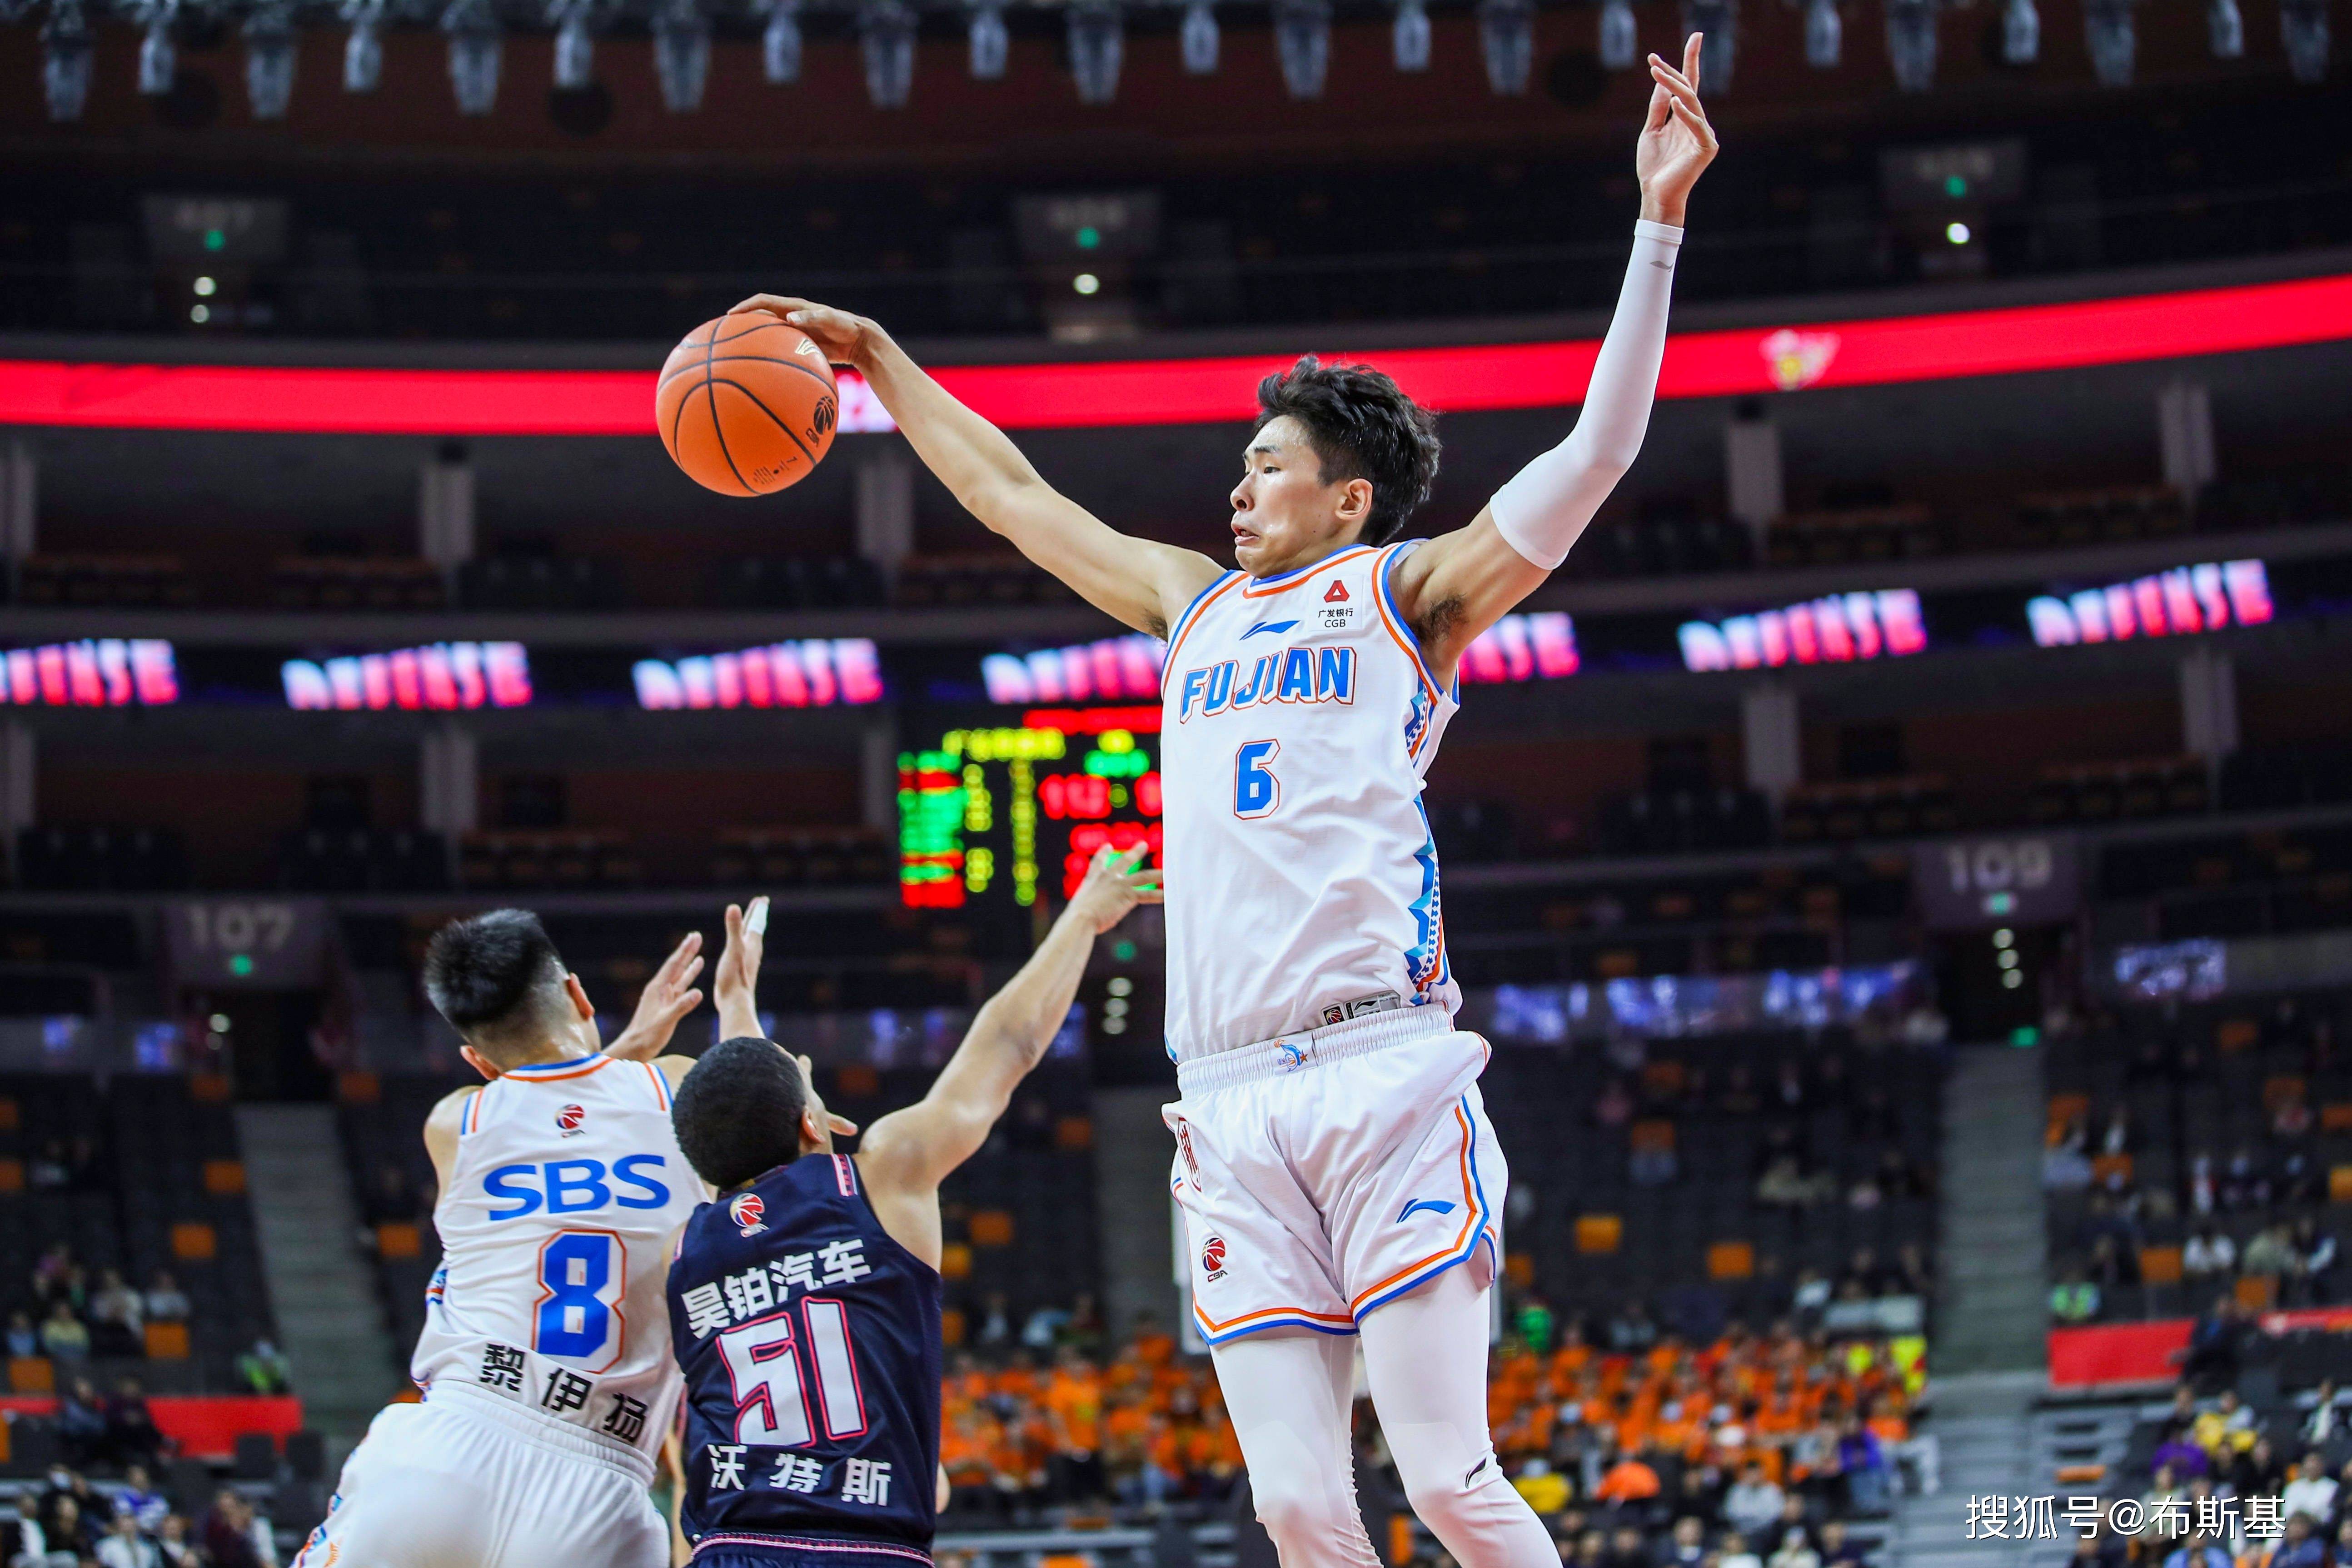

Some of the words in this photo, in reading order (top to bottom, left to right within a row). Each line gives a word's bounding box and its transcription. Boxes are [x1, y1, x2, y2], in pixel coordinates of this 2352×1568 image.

[1318, 608, 1353, 617] 广发银行
[1325, 619, 1346, 627] CGB
[1179, 646, 1356, 725] FUJIAN
[1234, 738, 1281, 821] 6
[1944, 839, 2053, 894] 109
[185, 902, 294, 950] 107
[483, 1154, 671, 1221] SBS
[532, 1229, 627, 1374] 8
[681, 1238, 872, 1339] 昊铂汽车
[1207, 1270, 1228, 1282] CBA
[478, 1343, 648, 1443] 黎伊扬
[715, 1295, 868, 1449] 51
[707, 1443, 892, 1507] 沃特斯
